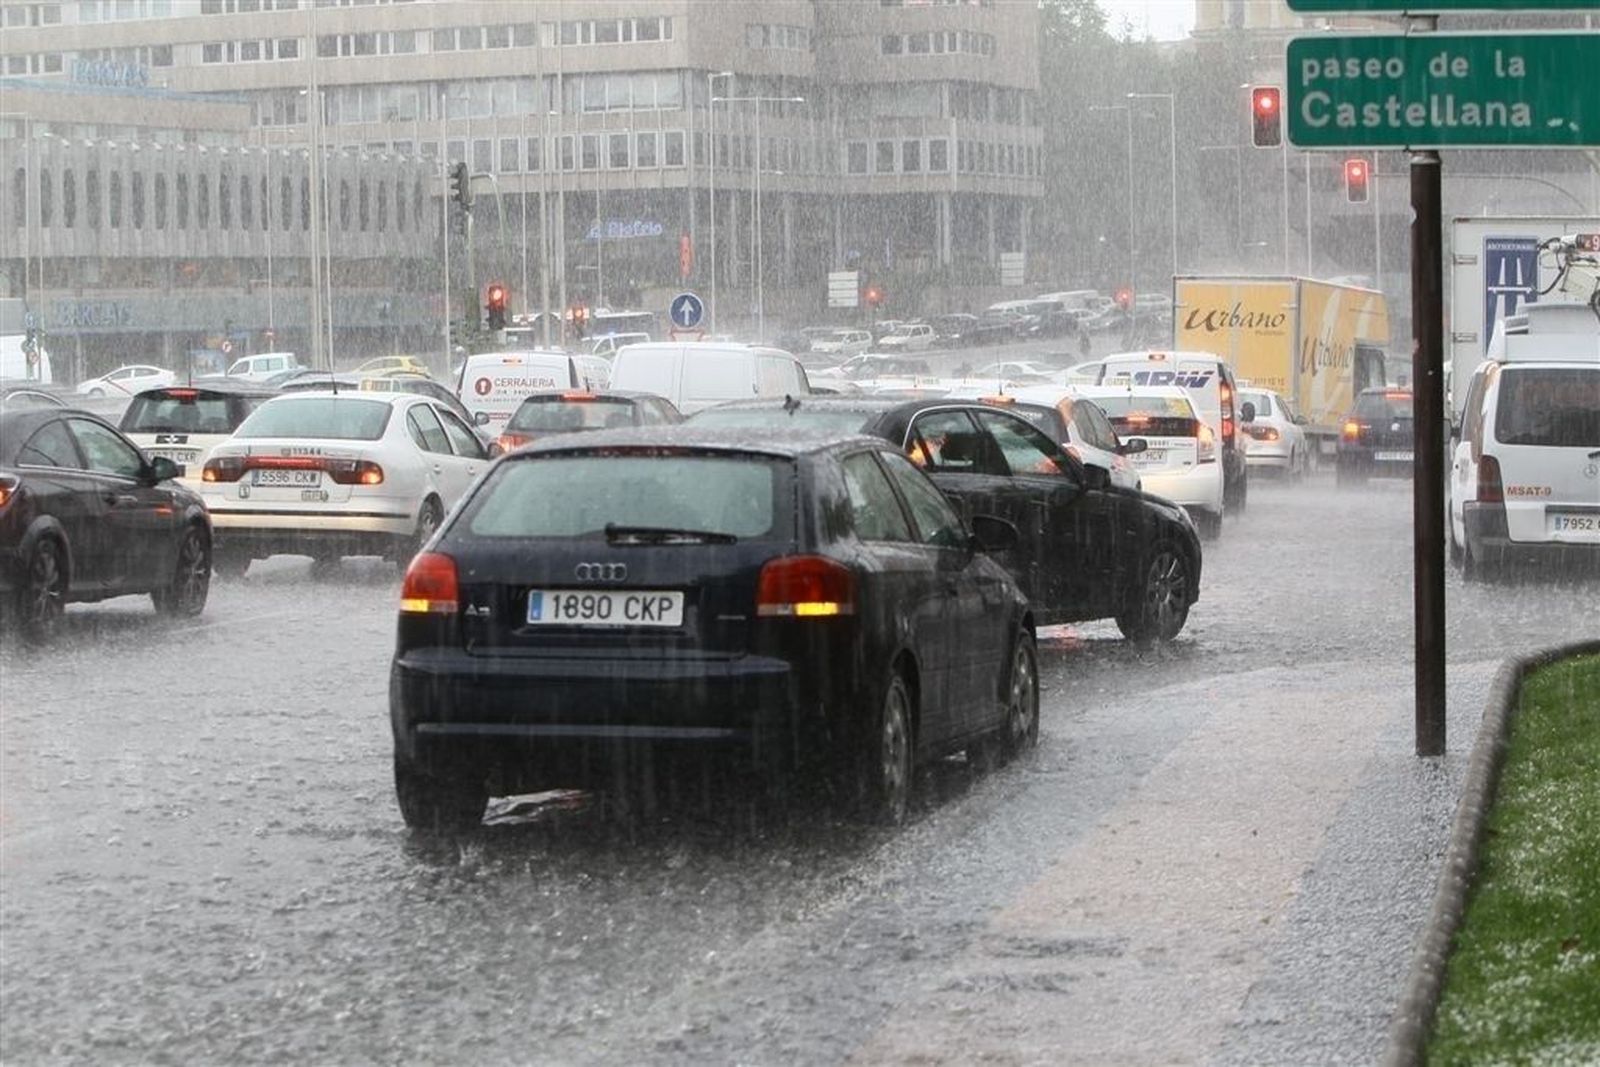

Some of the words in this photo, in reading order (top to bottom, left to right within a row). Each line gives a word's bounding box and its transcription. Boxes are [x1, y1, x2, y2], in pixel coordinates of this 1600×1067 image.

[1301, 57, 1405, 87] paseo
[1428, 51, 1469, 78] de
[1494, 49, 1526, 78] la
[1301, 90, 1532, 128] Castellana
[1563, 518, 1594, 531] 7952
[551, 594, 613, 620] 1890
[623, 596, 674, 621] CKP
